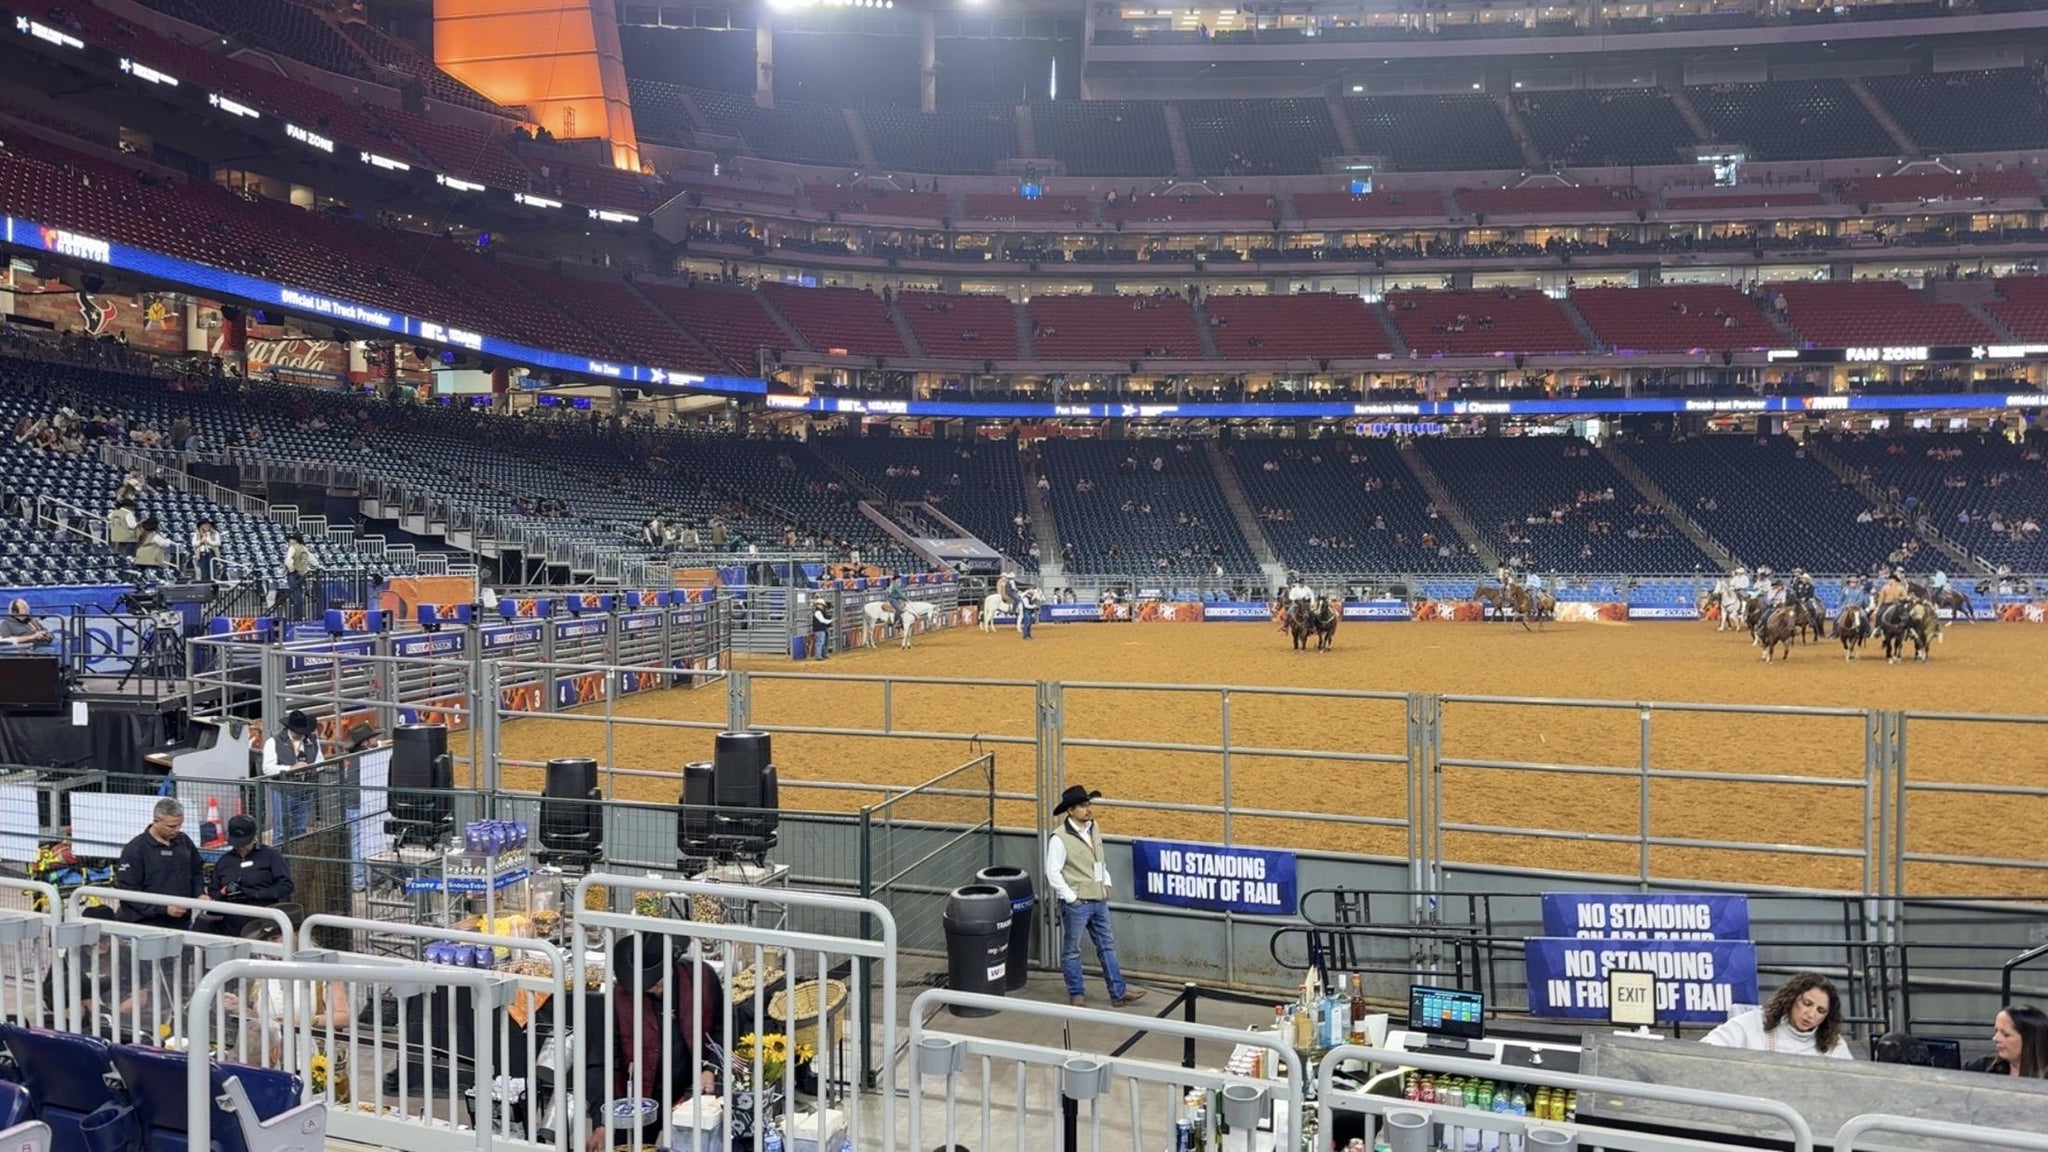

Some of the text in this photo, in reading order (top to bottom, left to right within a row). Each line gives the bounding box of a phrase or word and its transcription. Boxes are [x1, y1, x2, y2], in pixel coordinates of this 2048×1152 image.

[286, 123, 333, 152] FAN ZONE
[282, 289, 391, 327] Official Lift Truck Provider
[1846, 347, 1928, 361] FAN ZONE
[2006, 396, 2039, 406] Official
[1160, 850, 1266, 880] NO STANDING
[1148, 872, 1281, 906] IN FRONT OF RAIL
[1578, 903, 1711, 930] NO STANDING
[1565, 950, 1714, 980] NO STANDING
[1548, 980, 1571, 1007] IN
[1656, 982, 1679, 1010] OF
[1617, 987, 1647, 1003] EXIT
